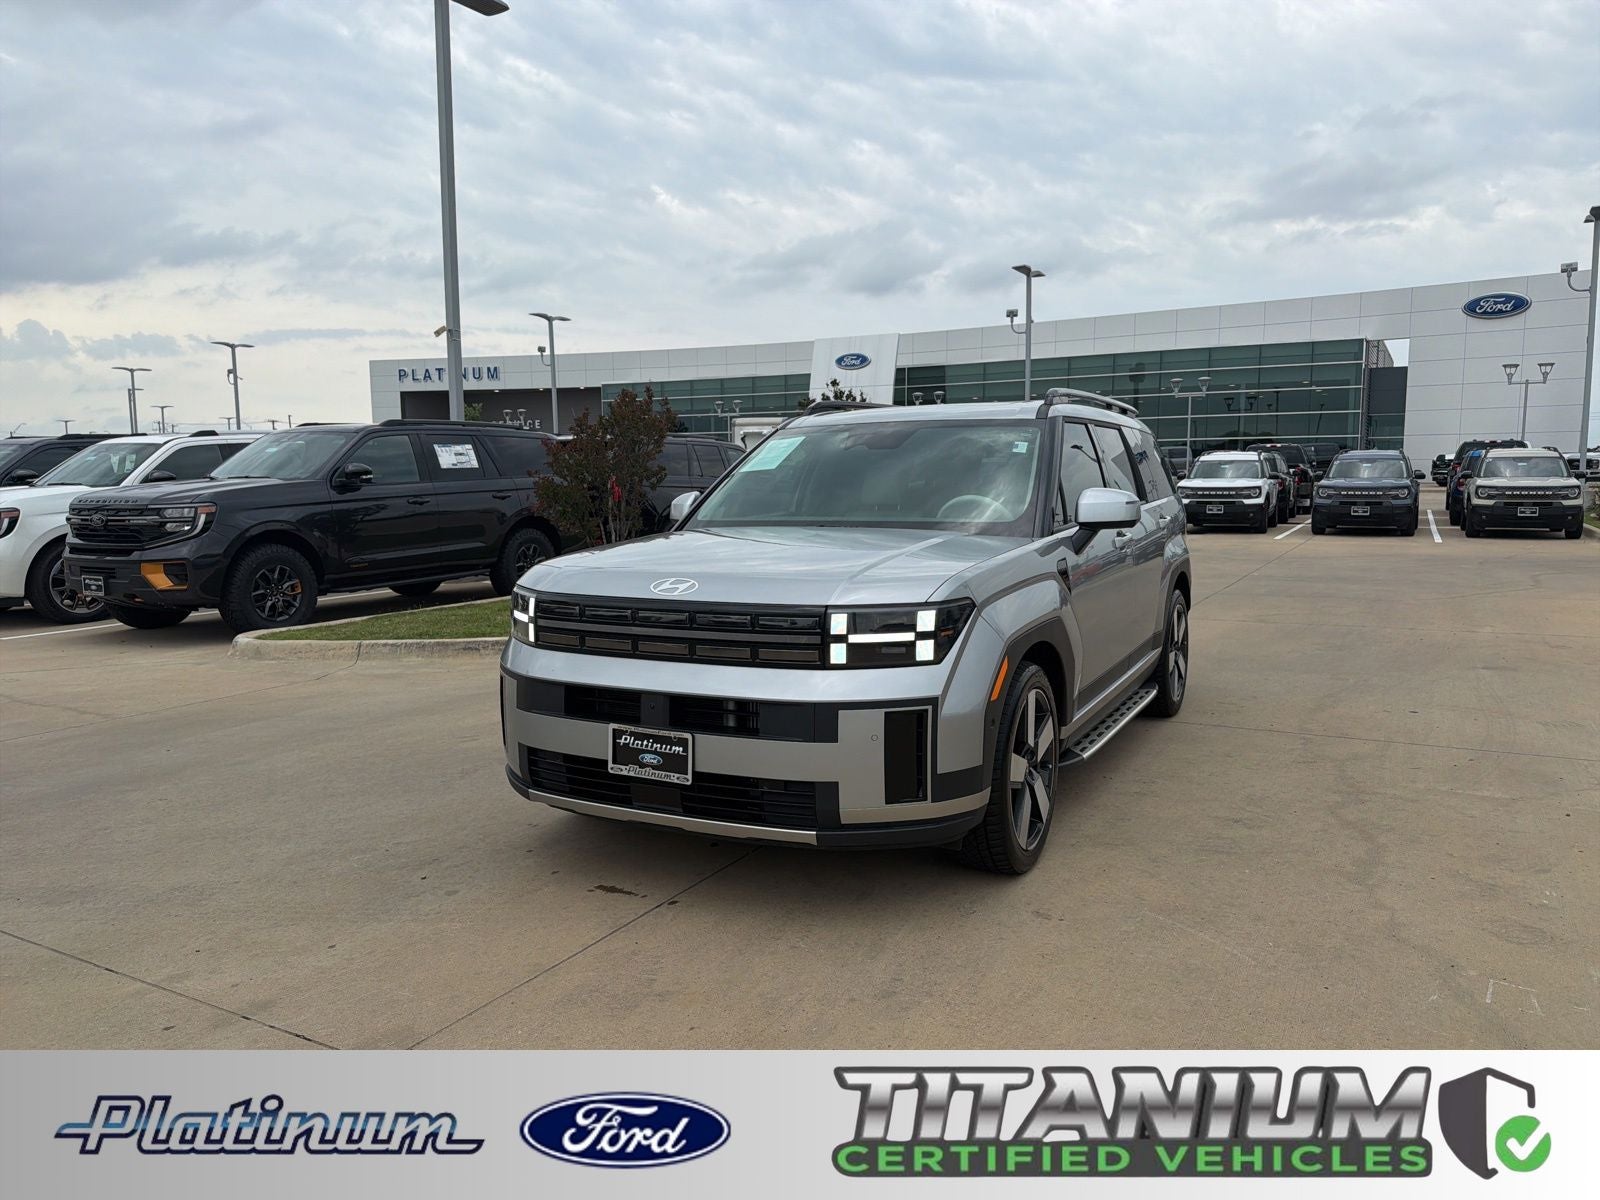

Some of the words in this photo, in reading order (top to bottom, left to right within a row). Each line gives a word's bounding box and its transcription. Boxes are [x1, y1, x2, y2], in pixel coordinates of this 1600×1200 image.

[1476, 297, 1515, 312] Ford
[841, 355, 862, 366] Ford
[398, 366, 499, 382] PLATNUM
[616, 735, 687, 755] Platinum
[627, 765, 676, 780] Platinum
